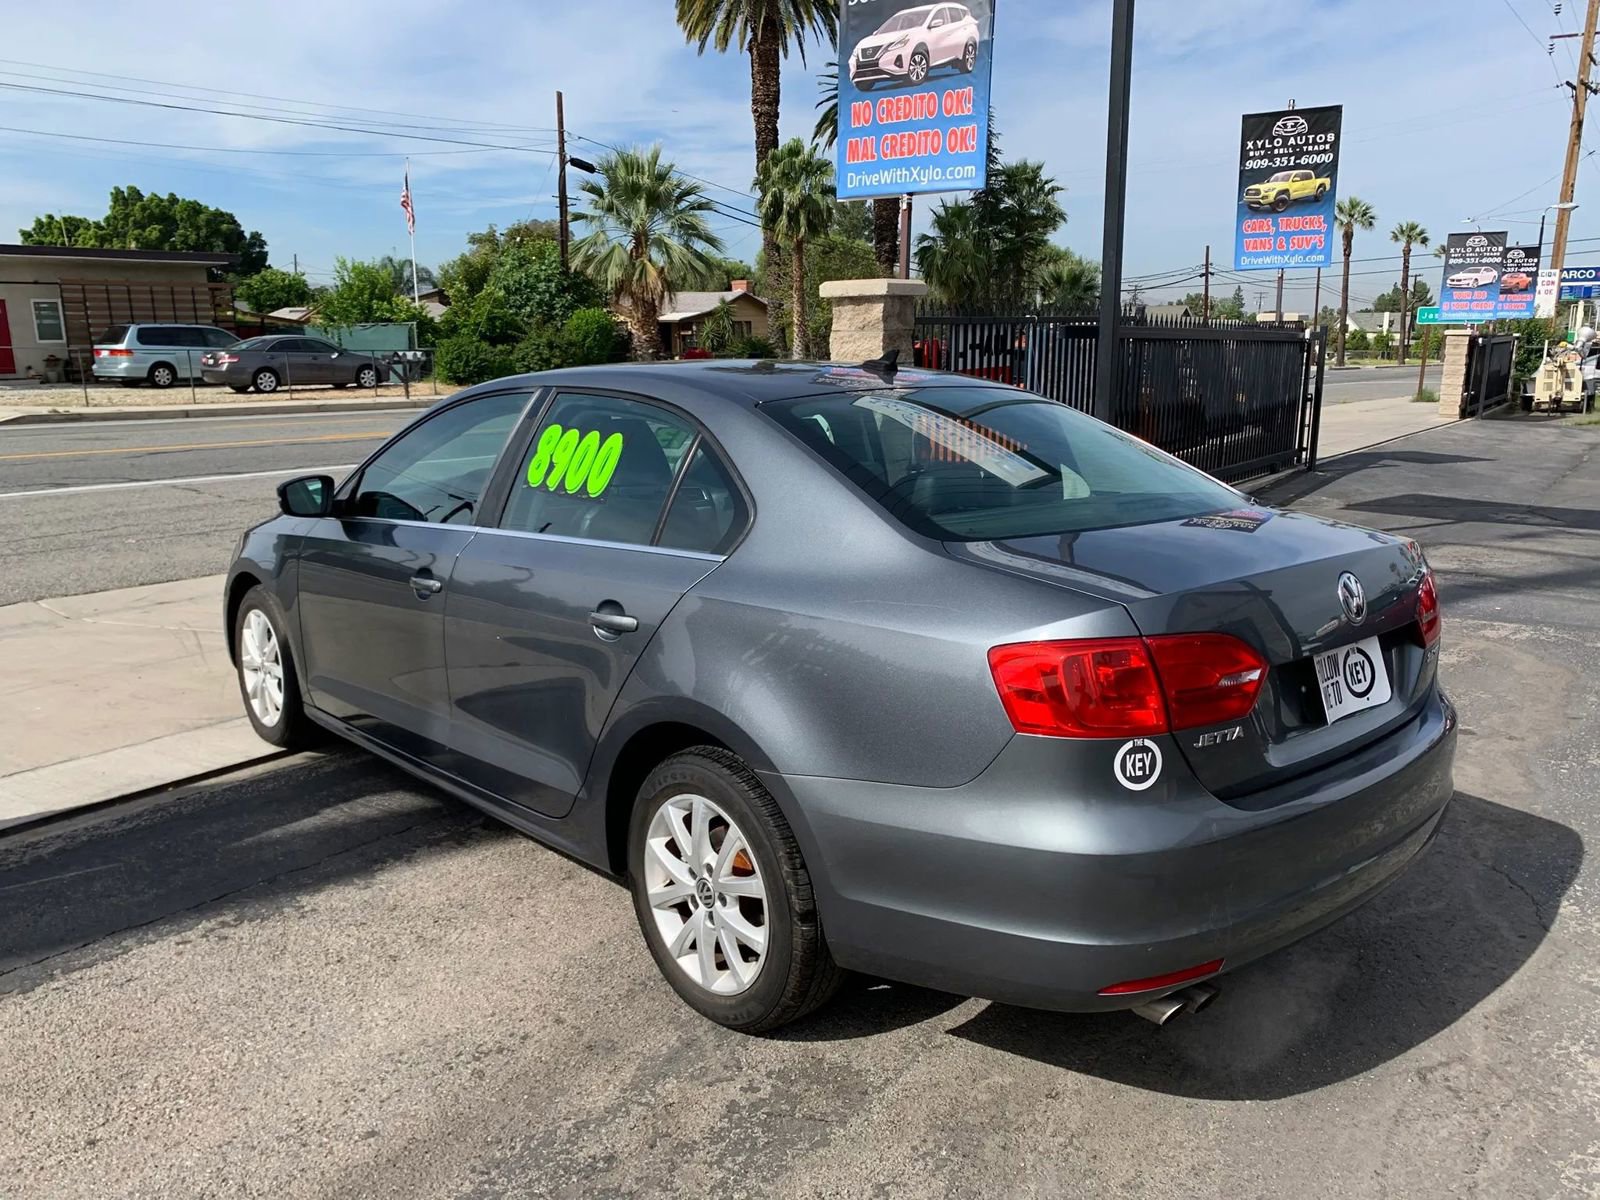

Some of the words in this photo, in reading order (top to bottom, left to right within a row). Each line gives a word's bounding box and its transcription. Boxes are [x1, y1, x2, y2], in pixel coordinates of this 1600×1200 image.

[852, 101, 872, 128] NO
[876, 92, 938, 124] CREDITO
[943, 86, 973, 116] OK!
[846, 136, 877, 164] MAL
[880, 129, 942, 160] CREDITO
[947, 125, 977, 154] OK!
[1246, 138, 1282, 150] XYLO
[1288, 133, 1335, 146] AUTOS
[1303, 144, 1330, 152] TRADE
[1245, 152, 1334, 170] 909-351-6000
[848, 165, 975, 188] DriveWithXylo.com
[1243, 218, 1276, 235] CARS,
[1279, 215, 1327, 232] TRUCKS,
[1244, 237, 1273, 252] VANS
[1276, 236, 1286, 250] &
[1290, 234, 1324, 250] SUV'S
[1241, 254, 1324, 266] DriveWithXylo.com
[1562, 270, 1596, 279] ARCO
[528, 424, 624, 498] 8900
[1348, 660, 1367, 686] KEY
[1331, 680, 1342, 706] TO
[1194, 726, 1245, 748] JETTA
[1126, 752, 1152, 777] KEY
